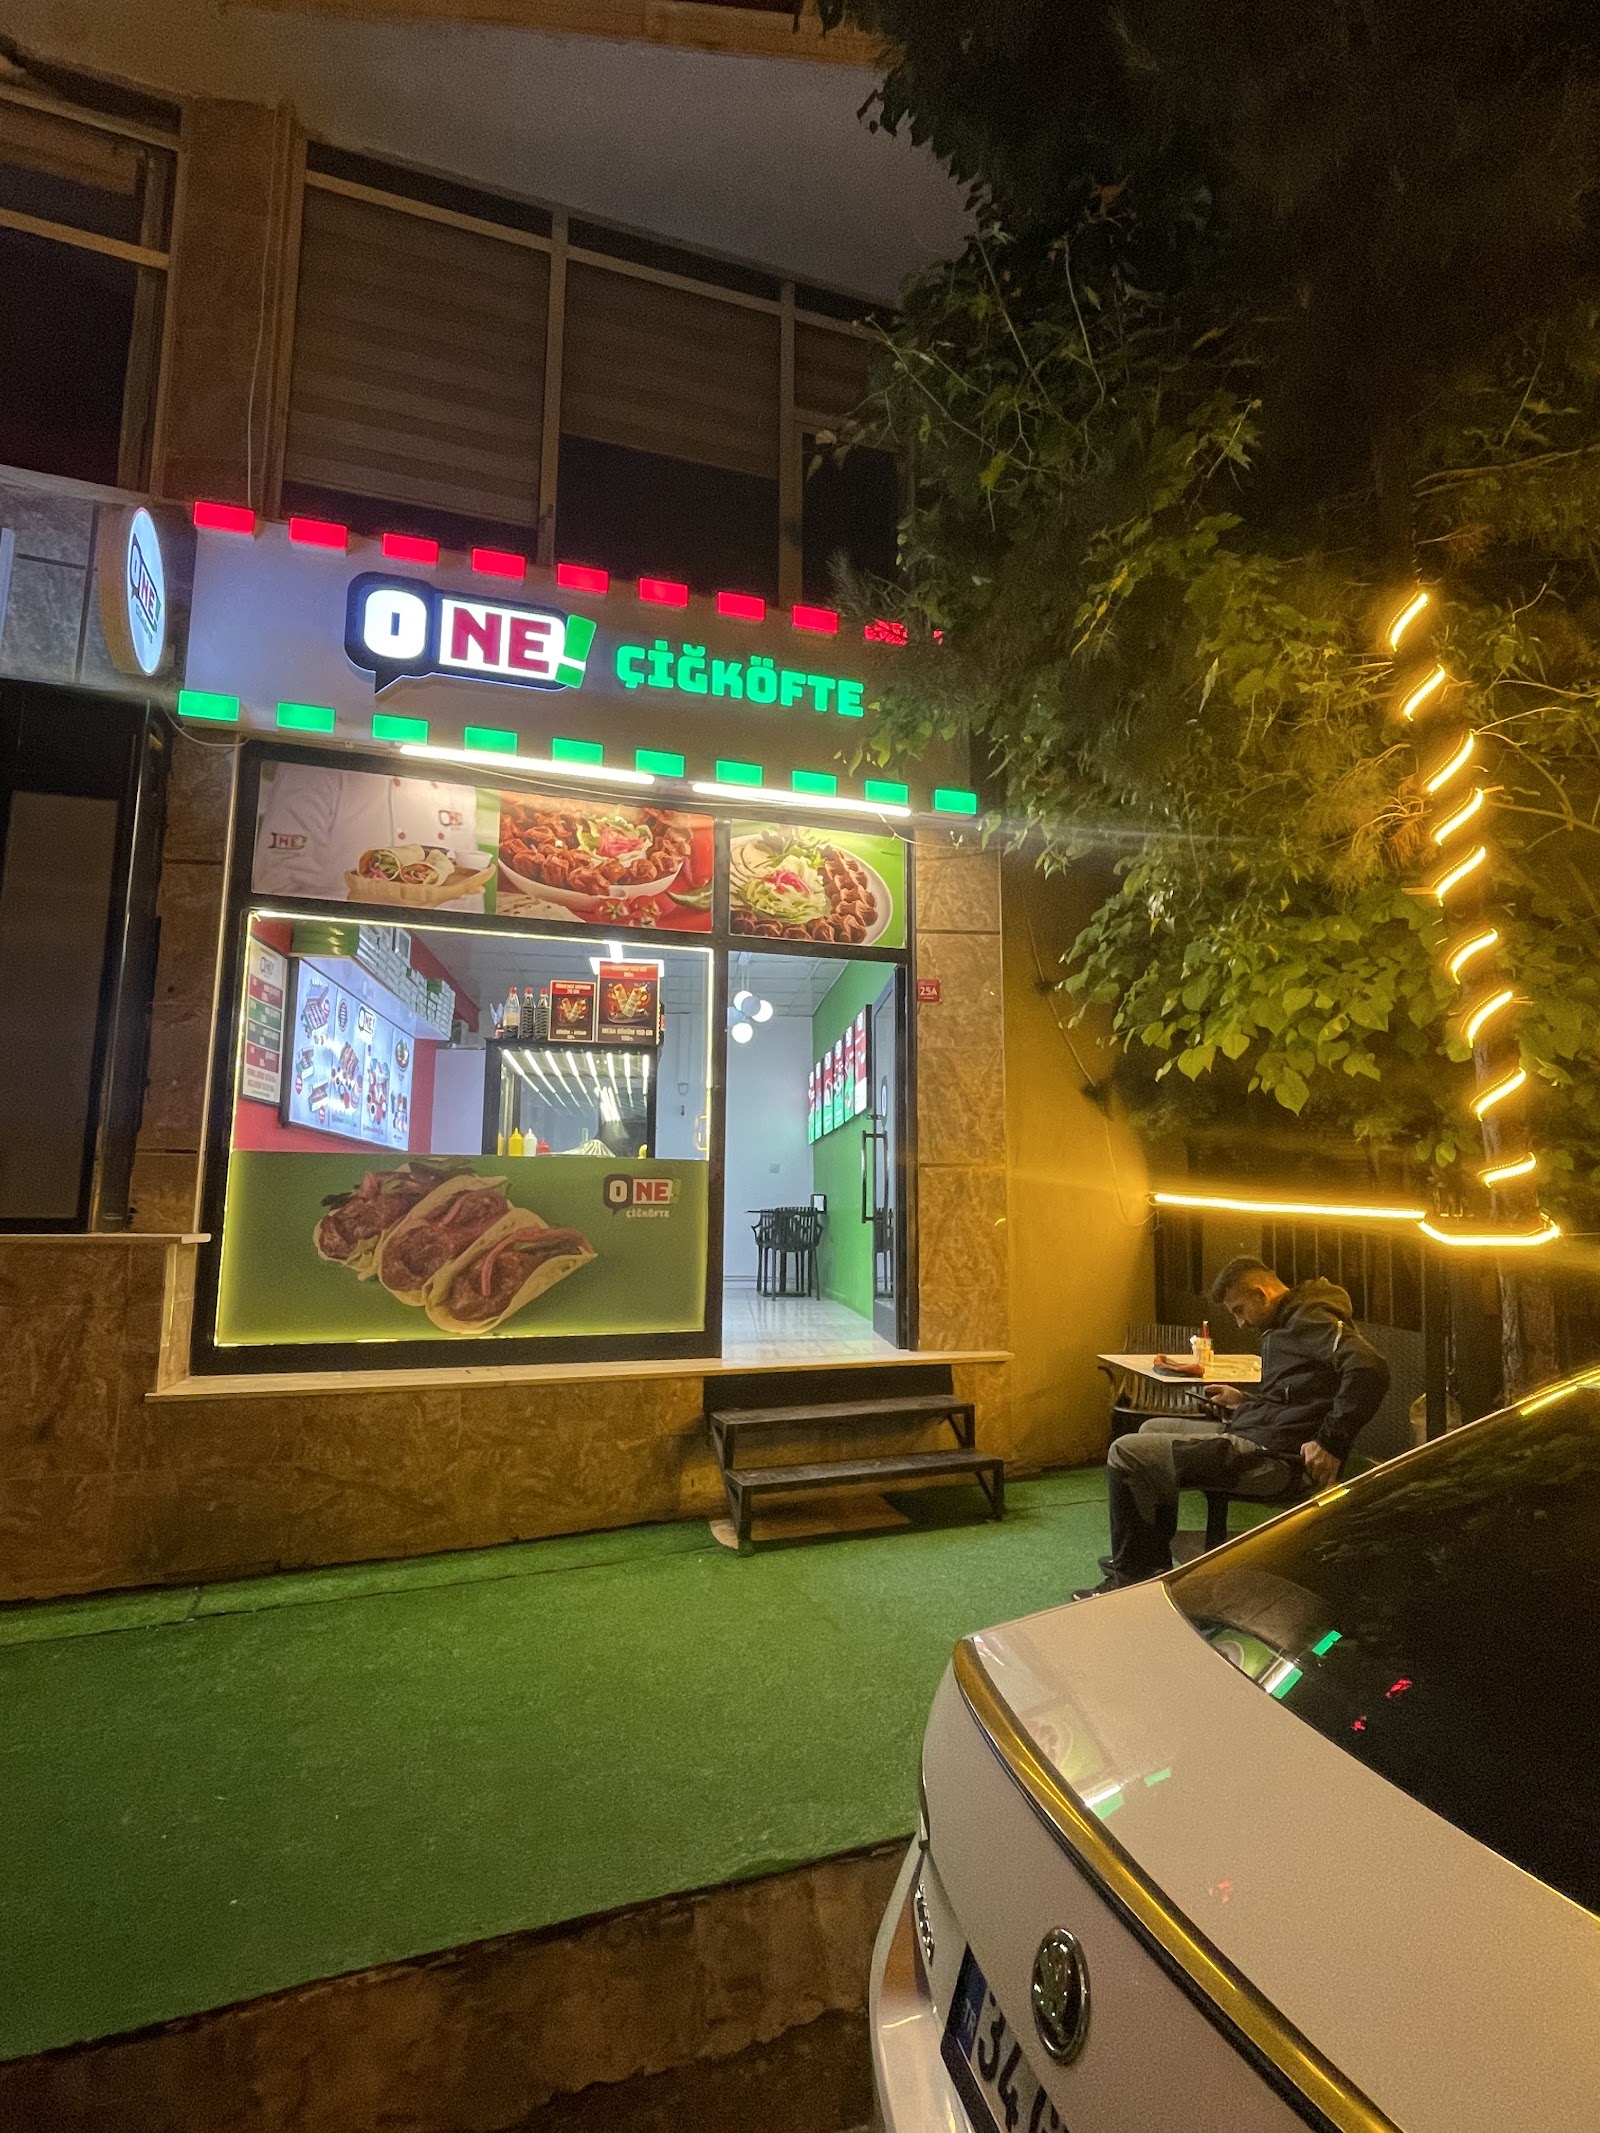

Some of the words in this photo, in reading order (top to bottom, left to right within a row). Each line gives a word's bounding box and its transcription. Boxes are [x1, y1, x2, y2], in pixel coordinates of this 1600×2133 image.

[363, 589, 597, 689] ONE!
[616, 639, 864, 718] ÇİĞKÖFTE
[919, 986, 938, 996] 25A
[626, 1208, 670, 1219] ÇİĞKÖFTE
